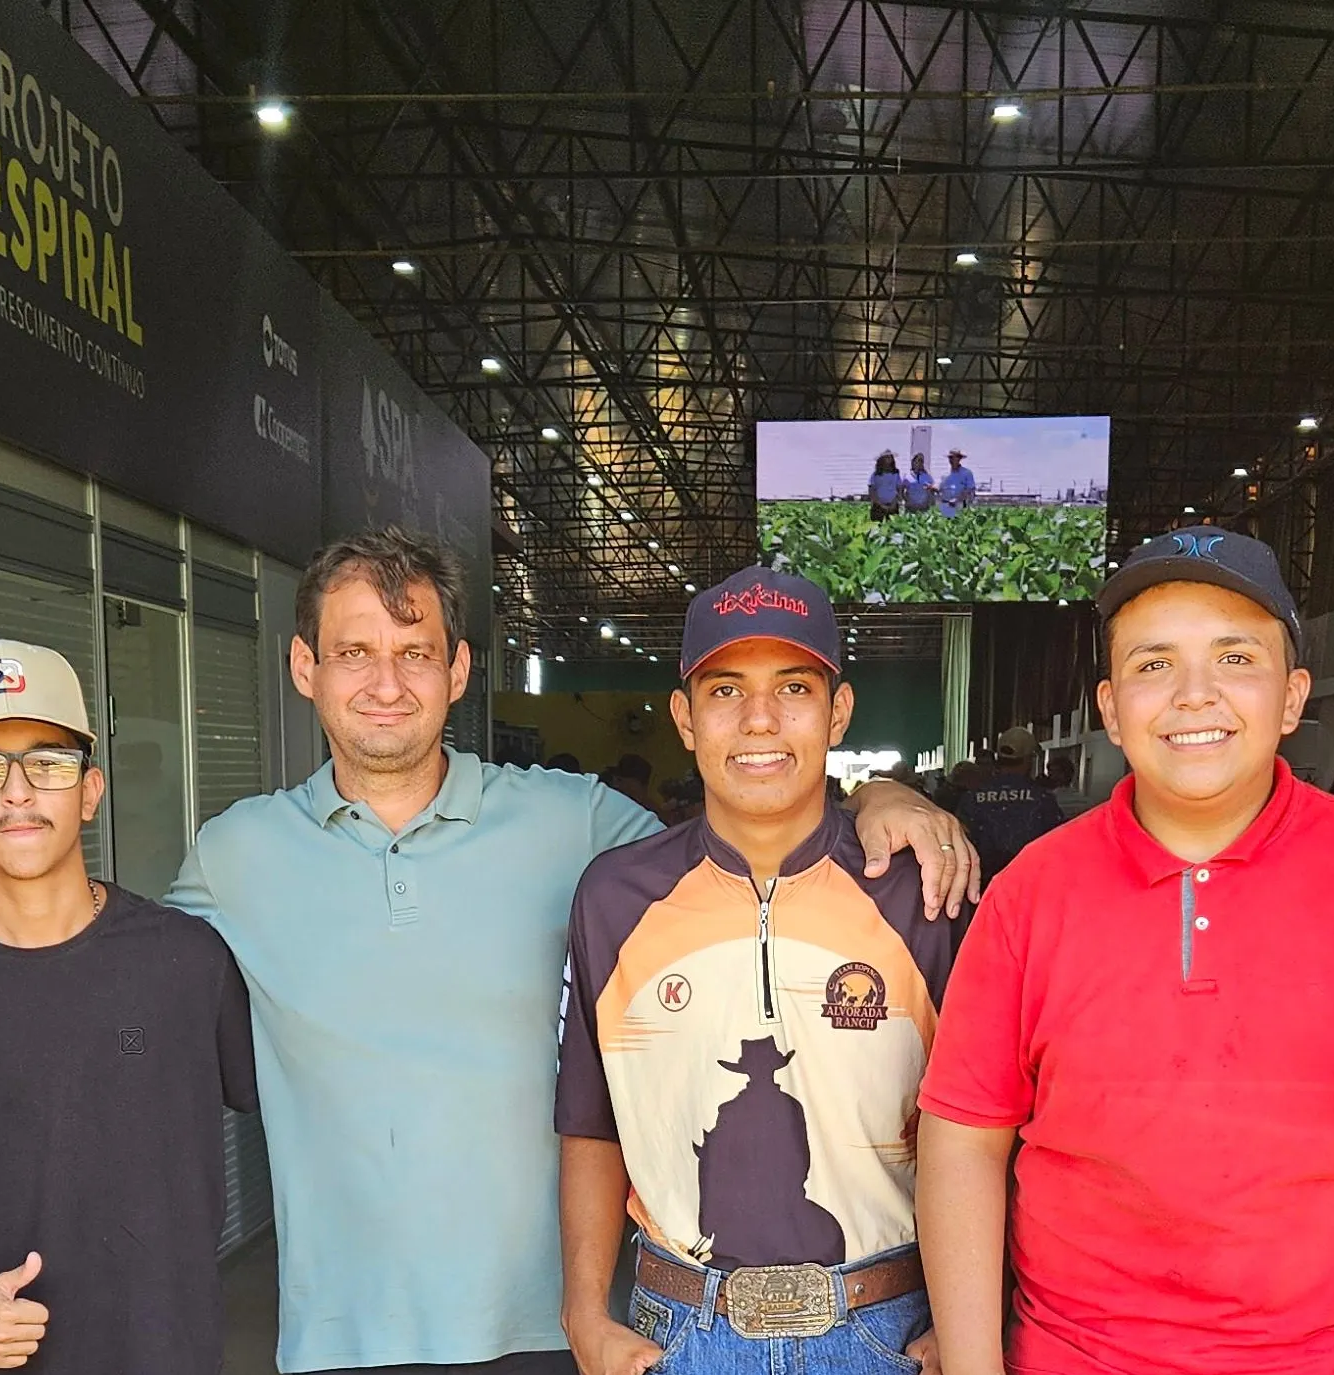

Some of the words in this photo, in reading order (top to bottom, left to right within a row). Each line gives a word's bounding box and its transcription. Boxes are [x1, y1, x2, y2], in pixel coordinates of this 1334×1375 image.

[87, 339, 145, 399] CONTÍNUO
[976, 789, 1034, 803] BRASIL
[665, 982, 684, 1004] K
[827, 1006, 883, 1018] ALVORADA
[835, 1017, 874, 1028] RANCH
